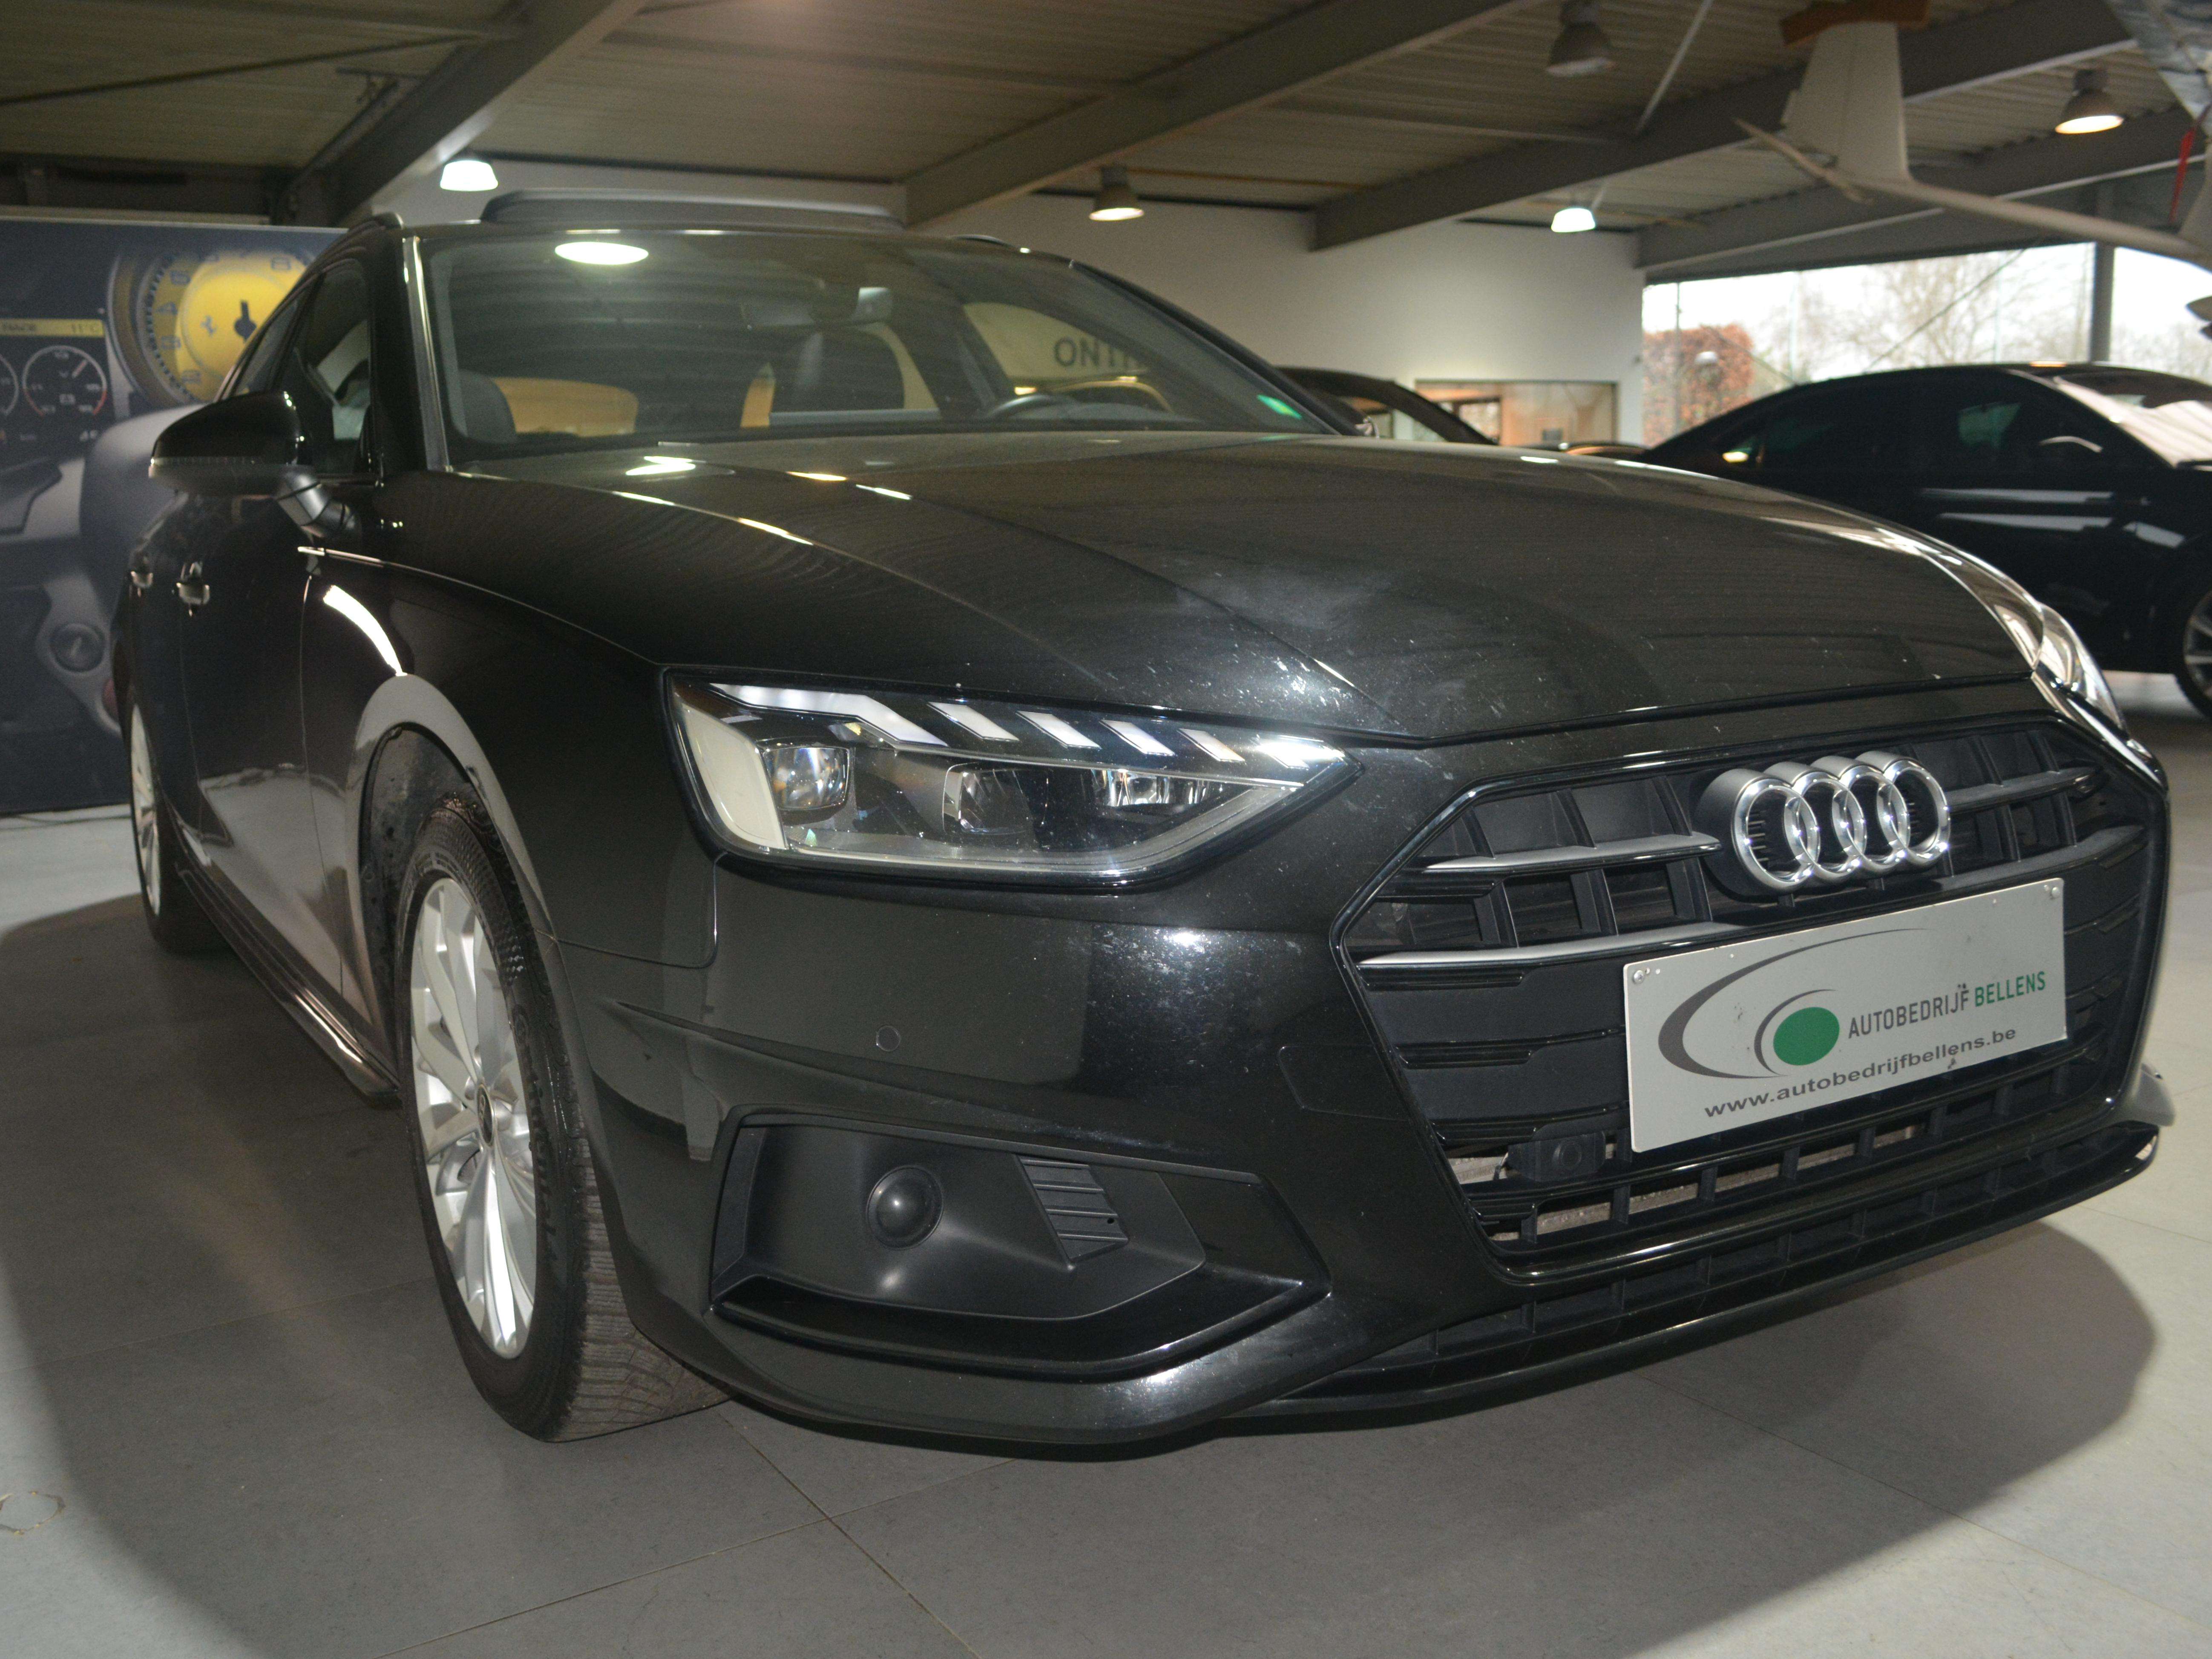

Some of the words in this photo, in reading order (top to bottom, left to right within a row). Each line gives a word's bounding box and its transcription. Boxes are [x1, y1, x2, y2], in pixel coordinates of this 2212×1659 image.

[1848, 989, 1969, 1038] AUTOBEDRIJF
[1975, 971, 2045, 1007] BELLENS
[1704, 1029, 2016, 1117] www.autobedrijfbellens.be
